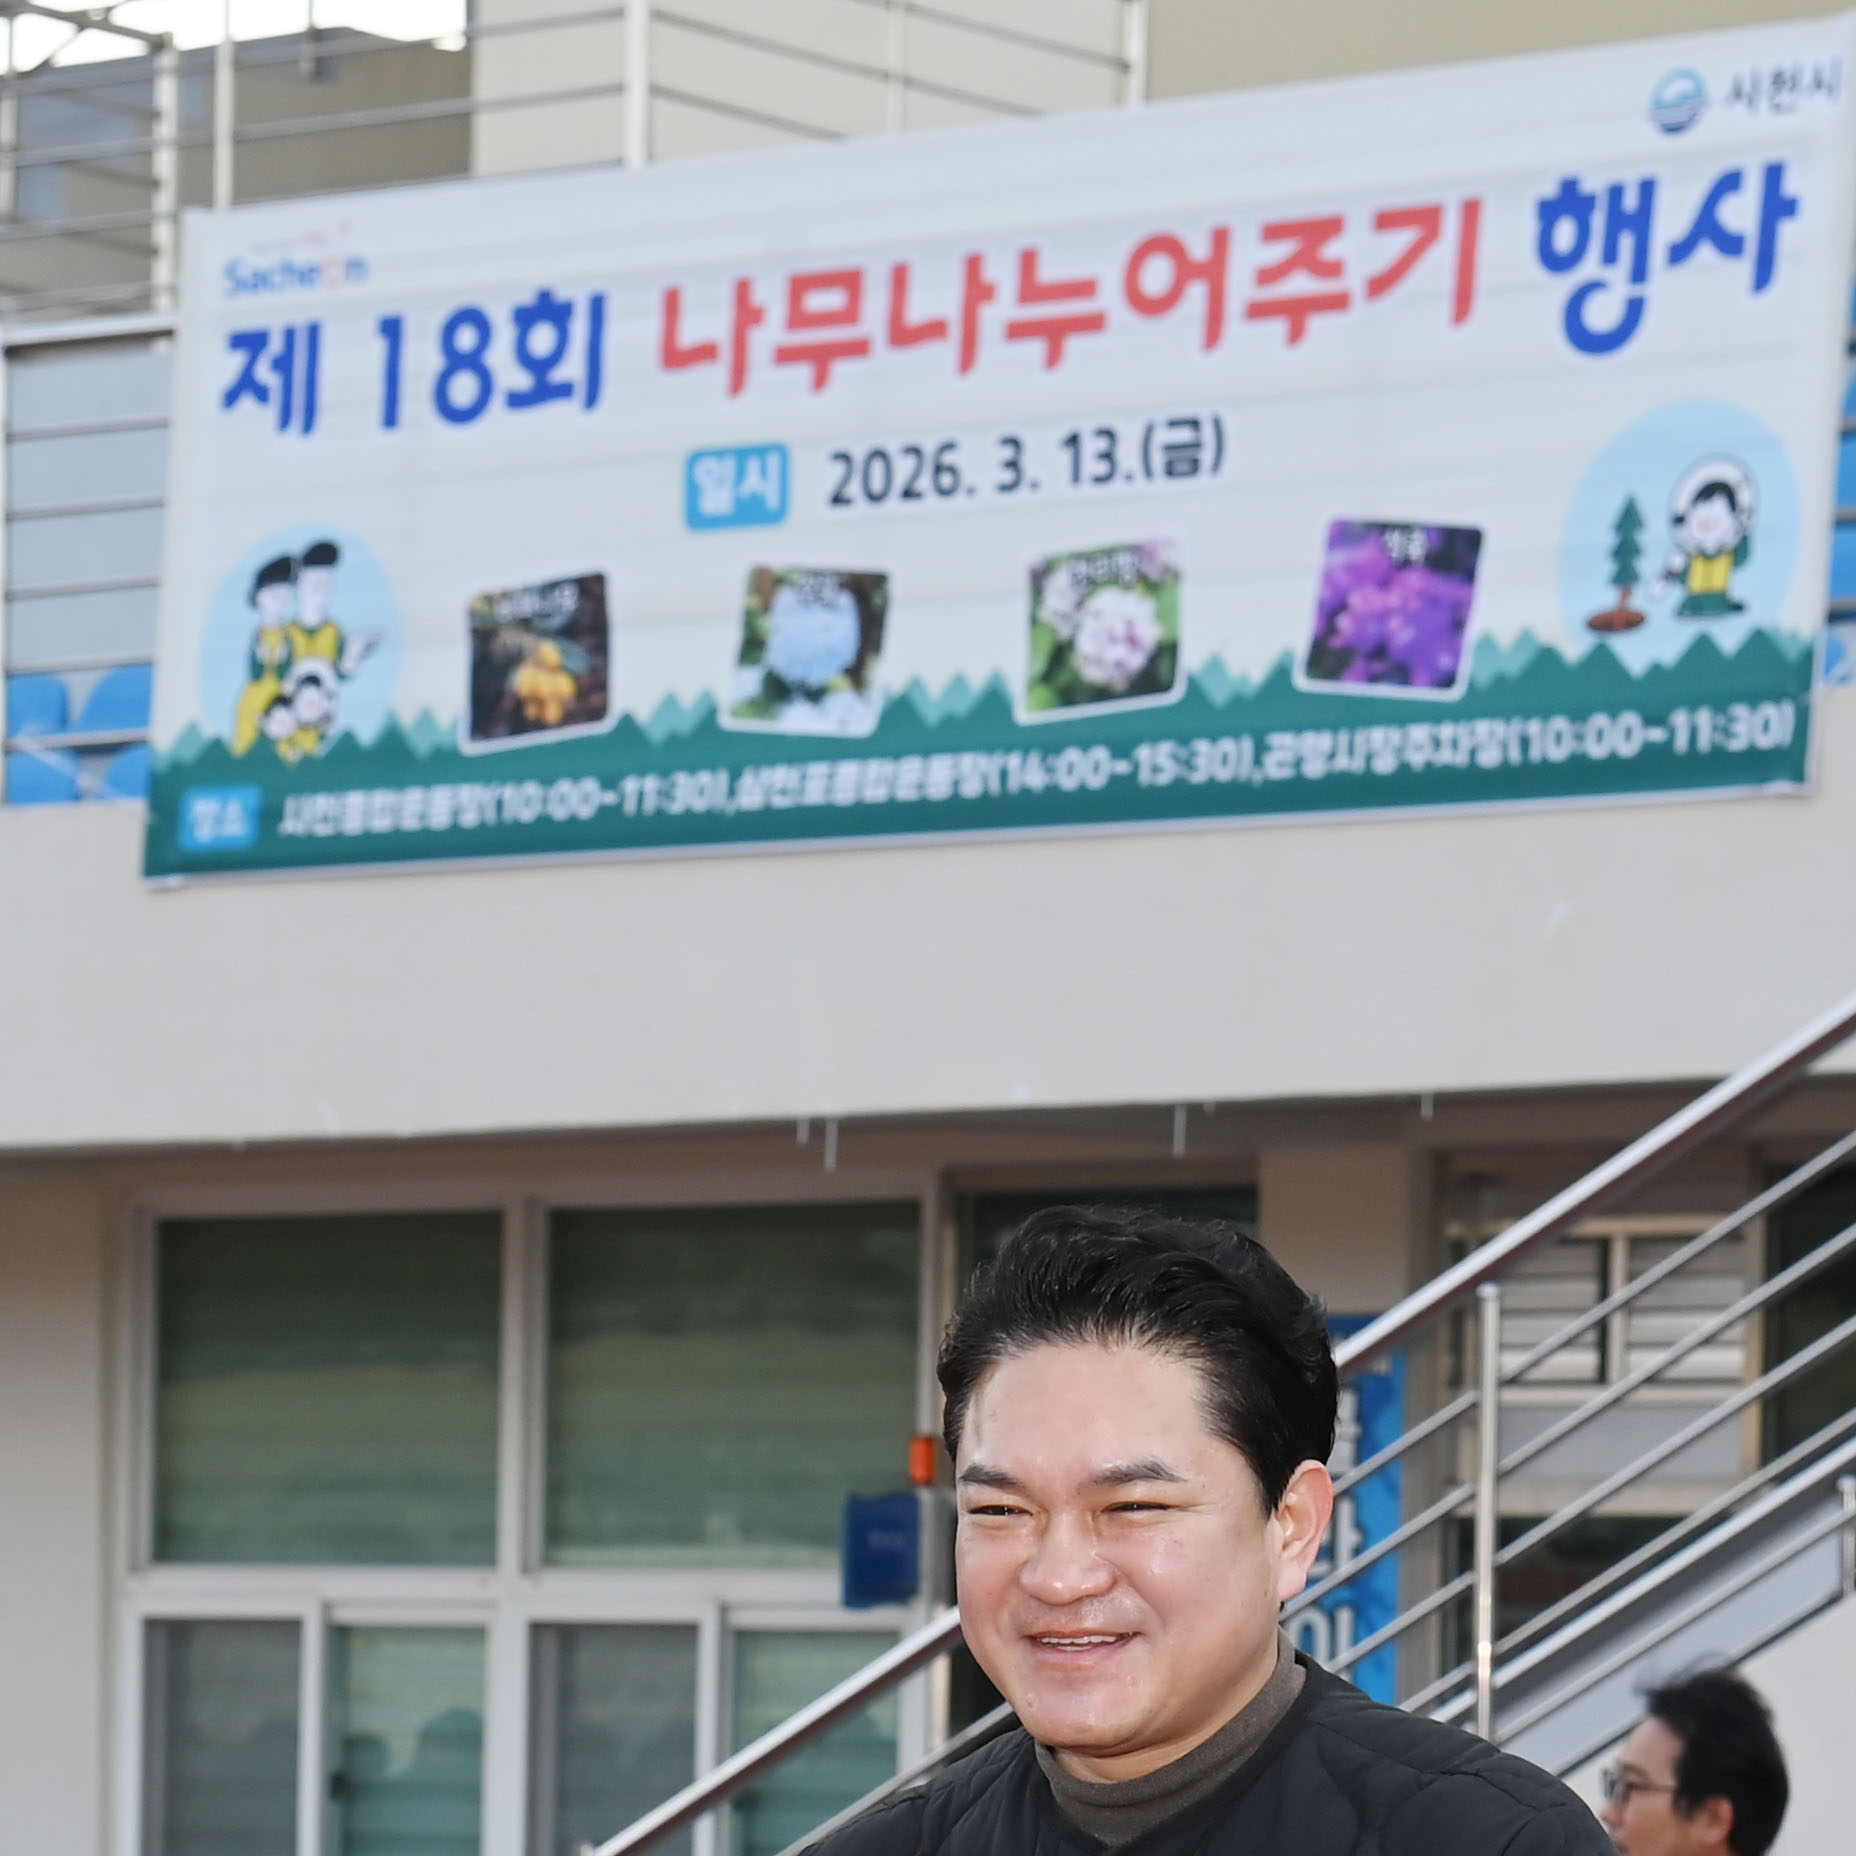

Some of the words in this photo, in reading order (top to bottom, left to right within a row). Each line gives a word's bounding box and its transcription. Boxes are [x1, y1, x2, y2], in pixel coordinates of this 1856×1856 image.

[221, 321, 321, 434] 제
[378, 287, 606, 430] 18회
[659, 197, 1485, 397] 나무나누어주기
[1536, 160, 1800, 357] 행사
[691, 450, 783, 519] 일시
[828, 441, 977, 508] 2026.
[996, 435, 1041, 493] 3.
[1059, 414, 1227, 487] 13.(금)
